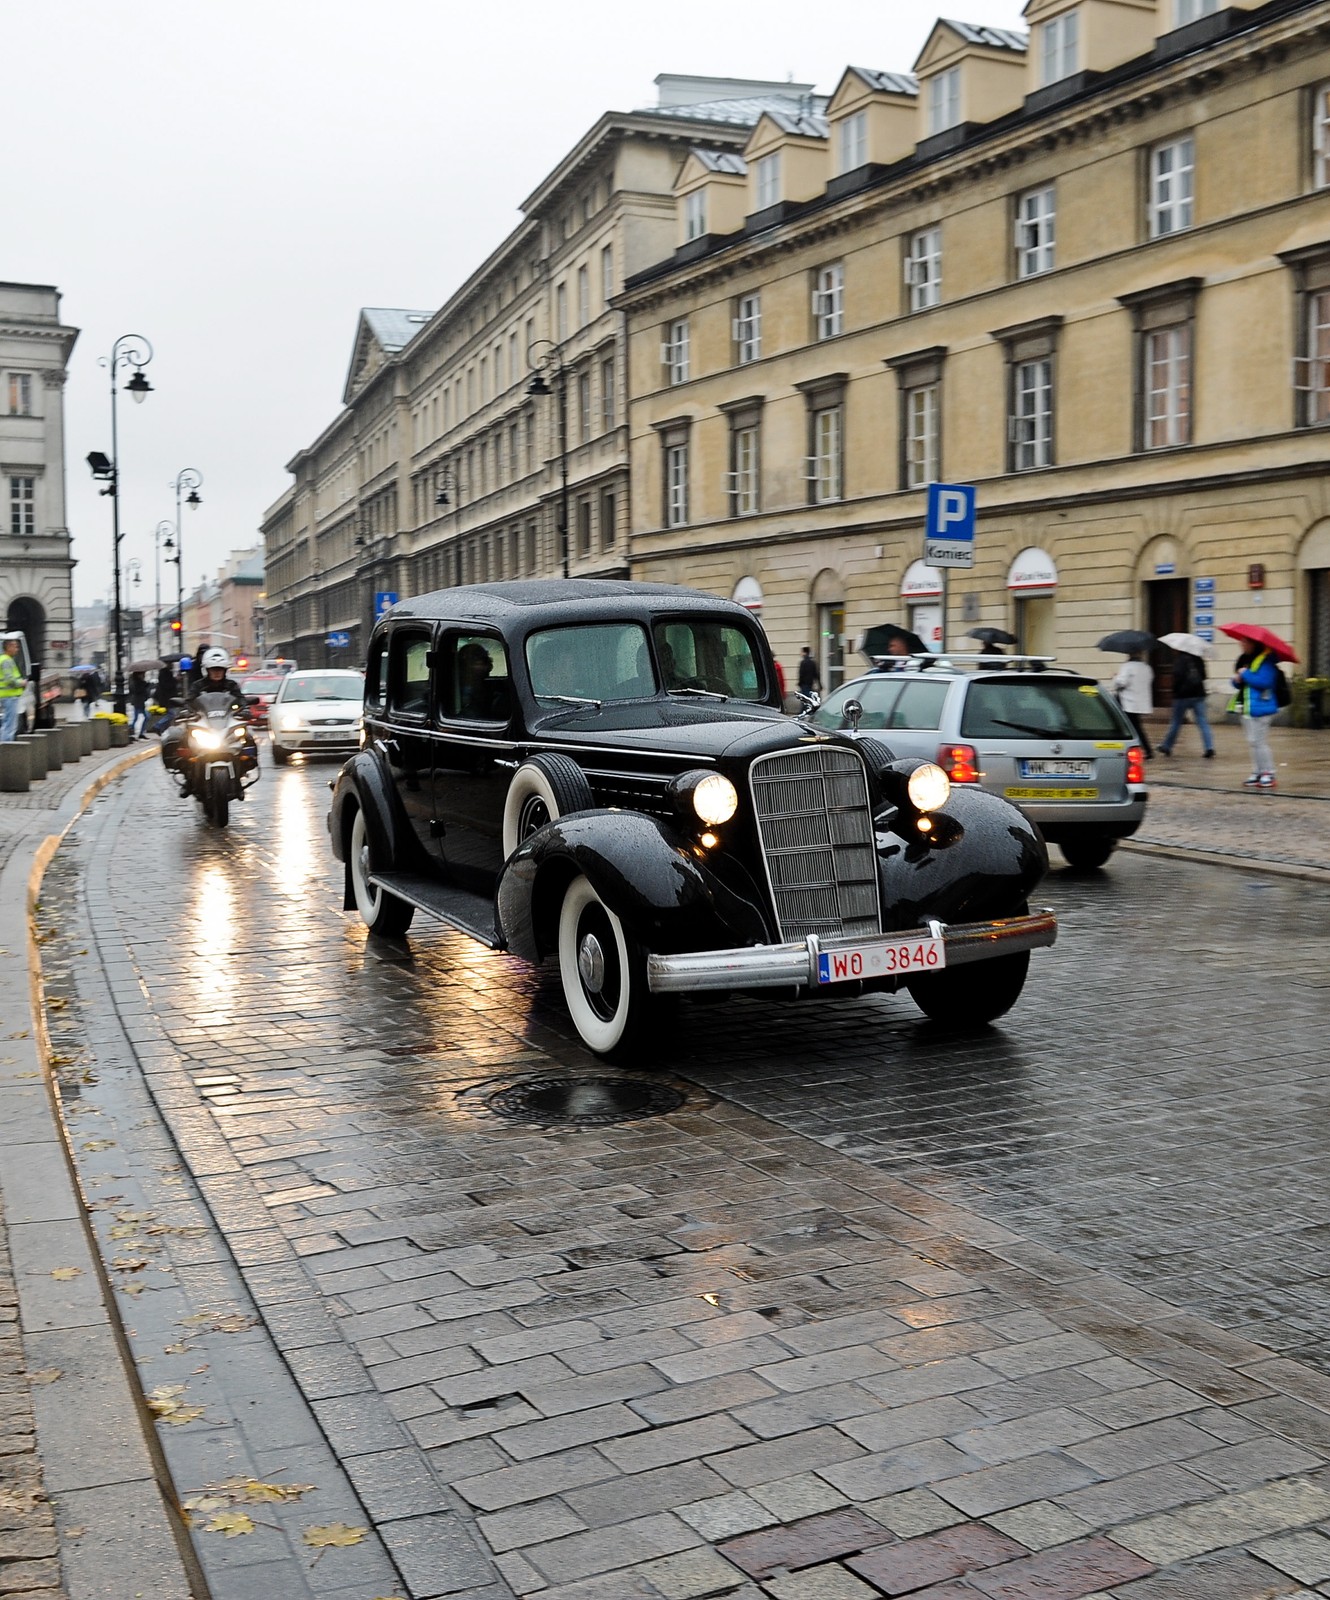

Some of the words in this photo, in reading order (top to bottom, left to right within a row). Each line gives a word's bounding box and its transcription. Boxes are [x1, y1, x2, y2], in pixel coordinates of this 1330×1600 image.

[937, 490, 967, 532] P
[927, 545, 972, 560] Koniec
[886, 944, 938, 971] 3846
